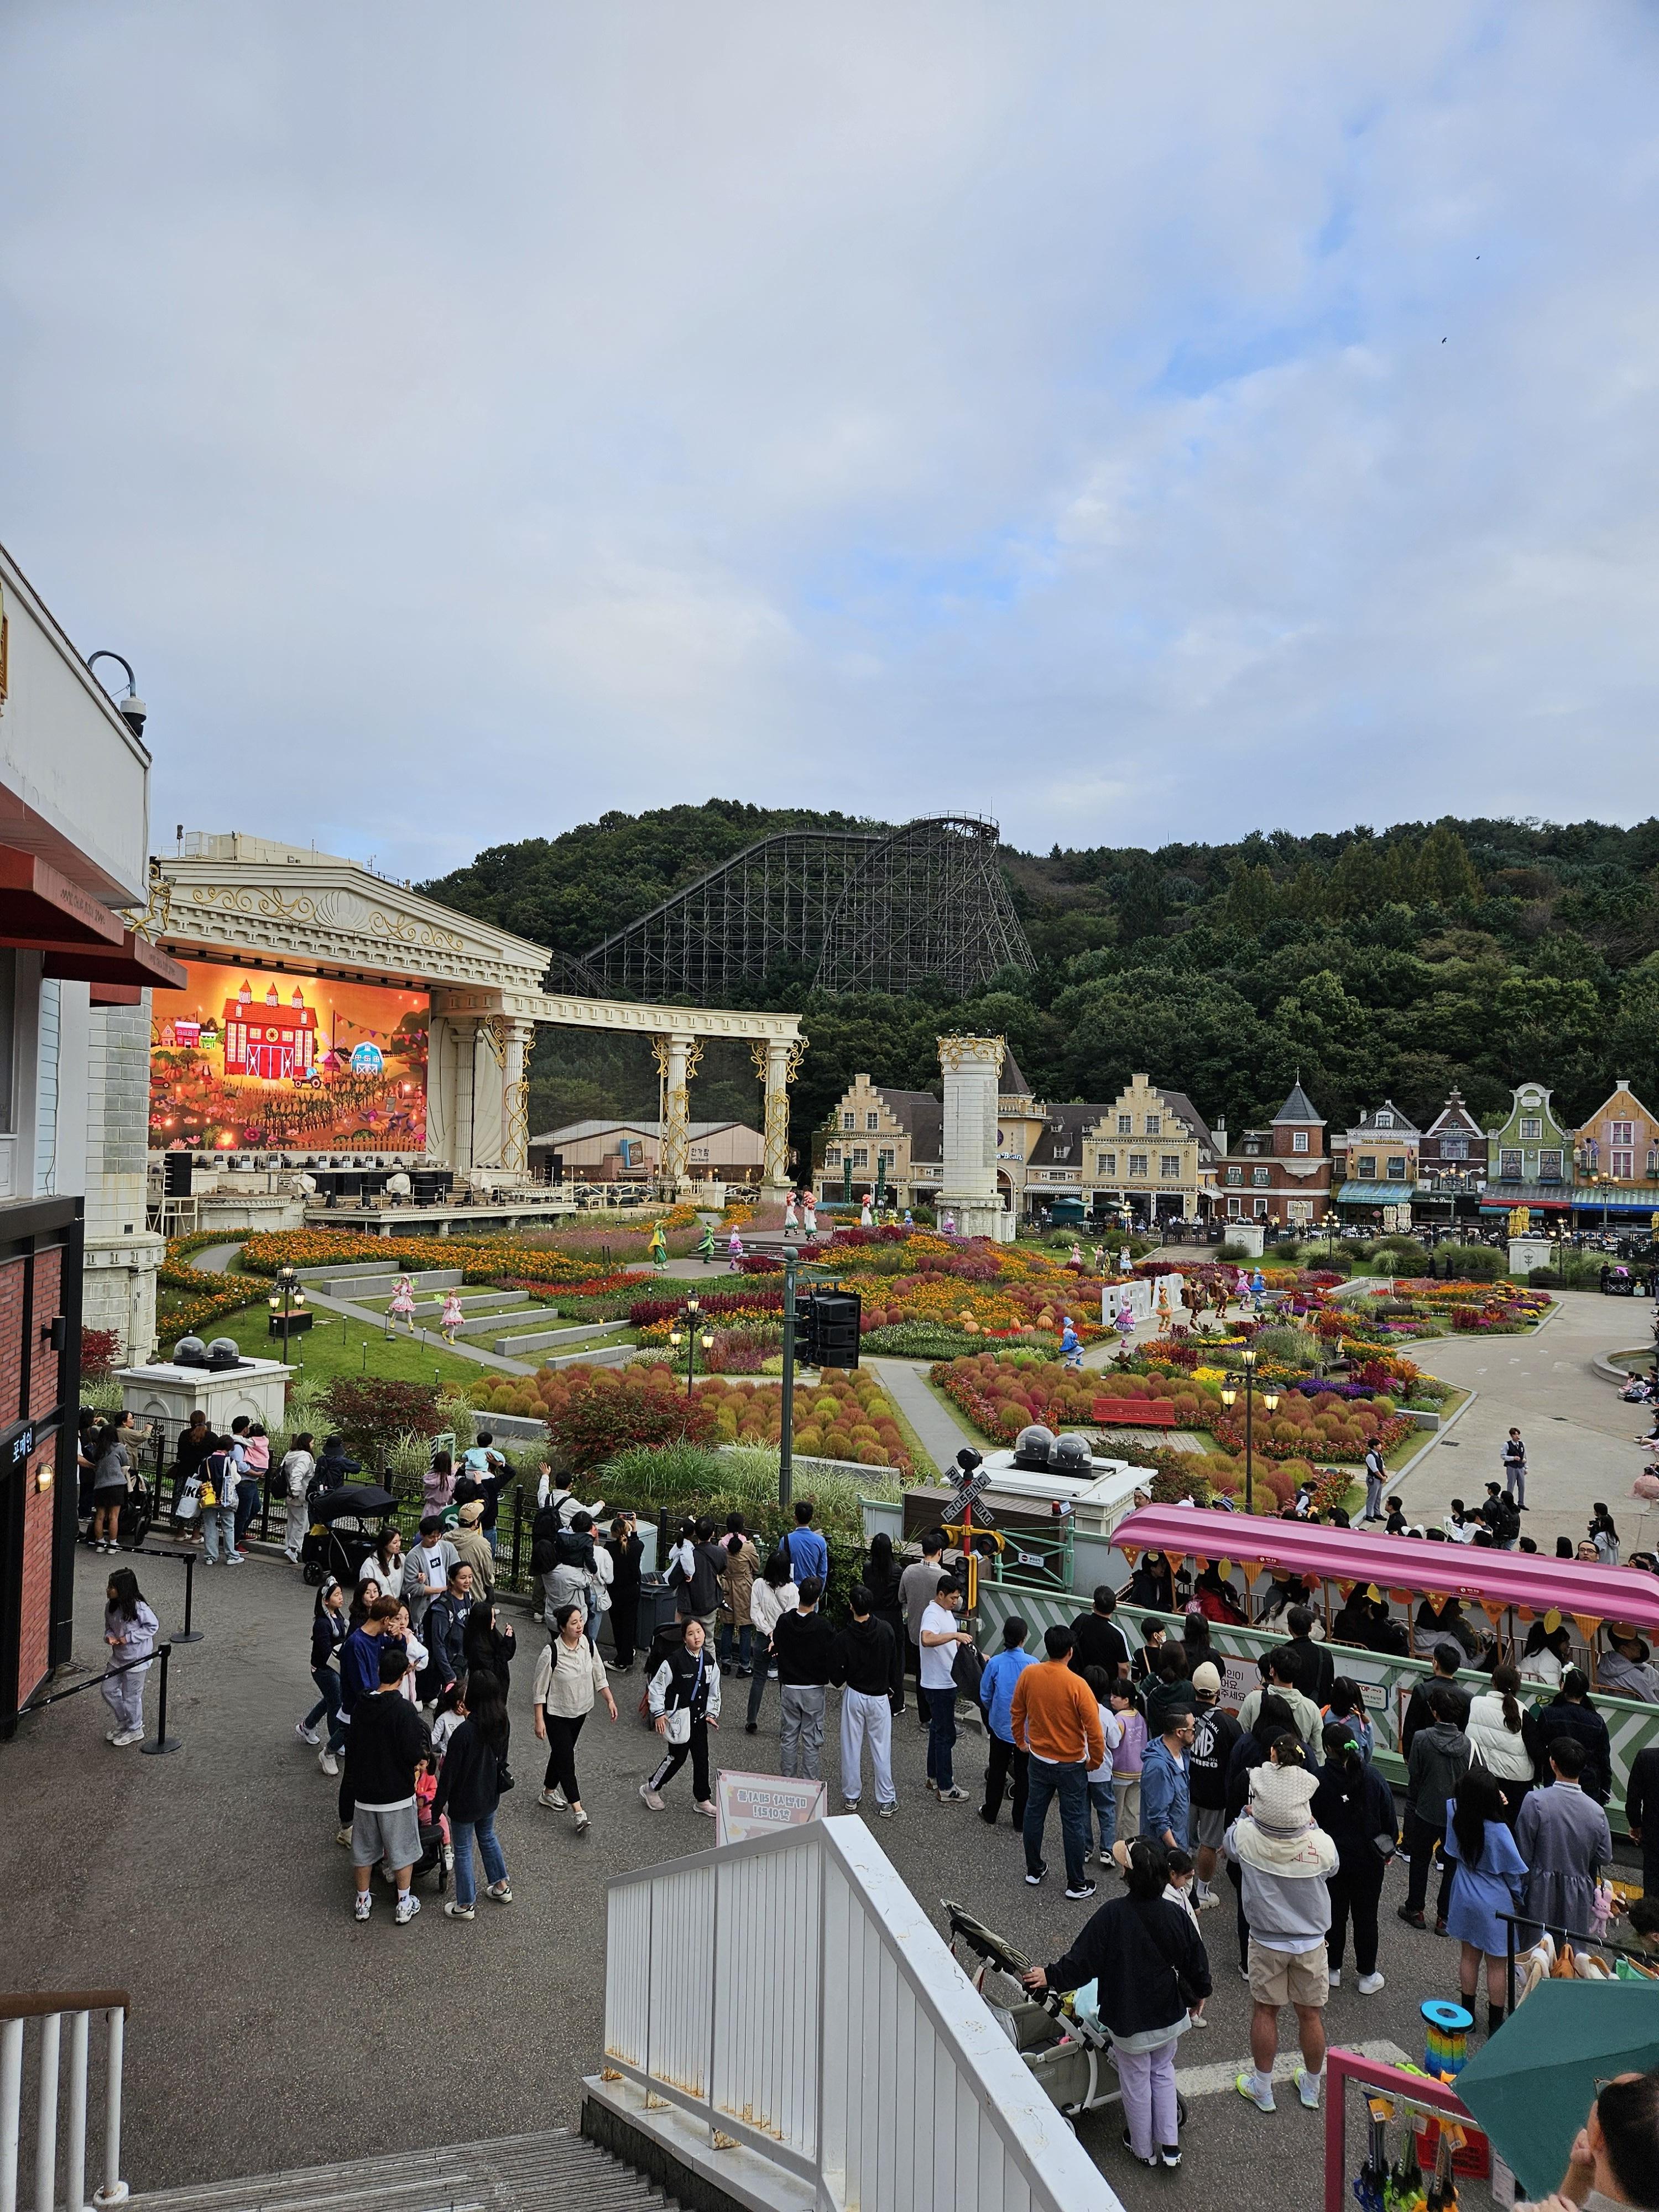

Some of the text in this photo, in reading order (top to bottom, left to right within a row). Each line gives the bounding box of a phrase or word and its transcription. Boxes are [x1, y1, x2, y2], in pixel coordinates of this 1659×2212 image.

[947, 1469, 966, 1493] RAIL
[943, 1477, 987, 1520] CROSSING
[973, 1499, 993, 1524] ROAD
[1224, 1669, 1244, 1681] 인이
[1218, 1688, 1246, 1702] 주세요
